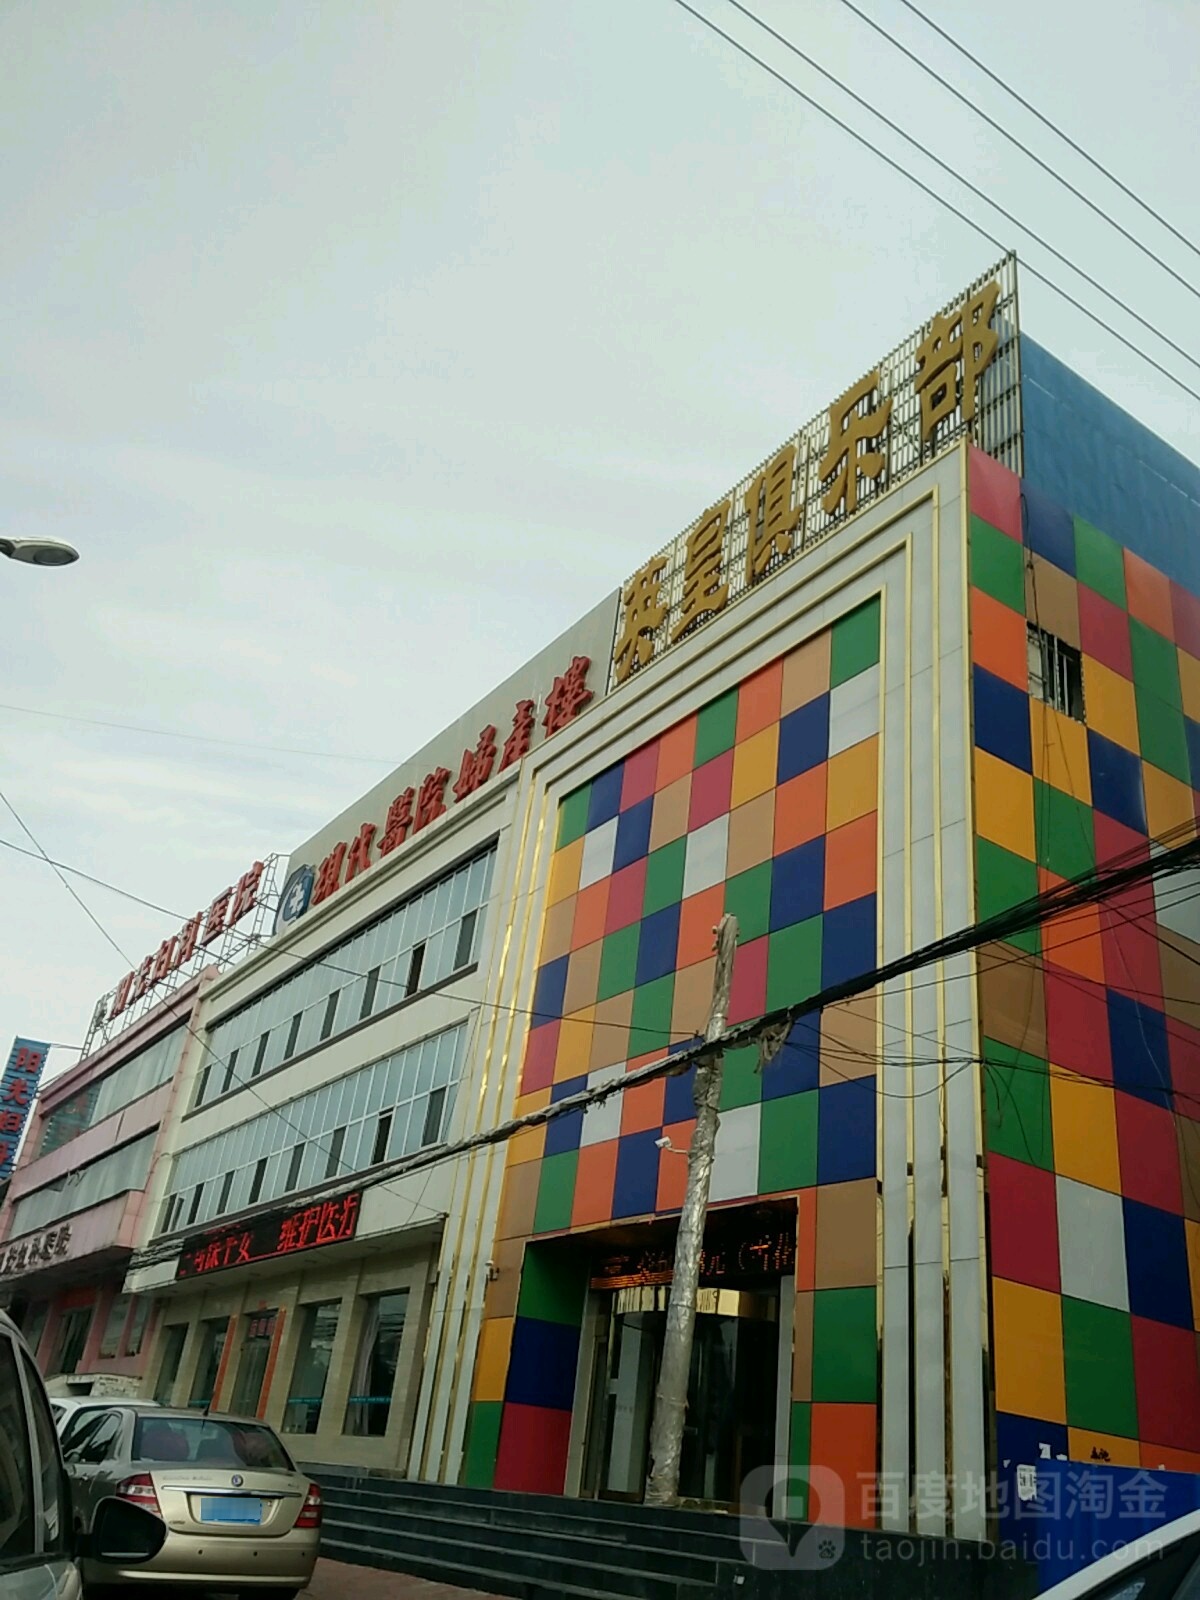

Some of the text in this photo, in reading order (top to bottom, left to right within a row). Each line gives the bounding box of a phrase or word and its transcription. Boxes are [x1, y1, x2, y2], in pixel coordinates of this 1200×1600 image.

[612, 280, 1001, 683] 英皇俱乐部
